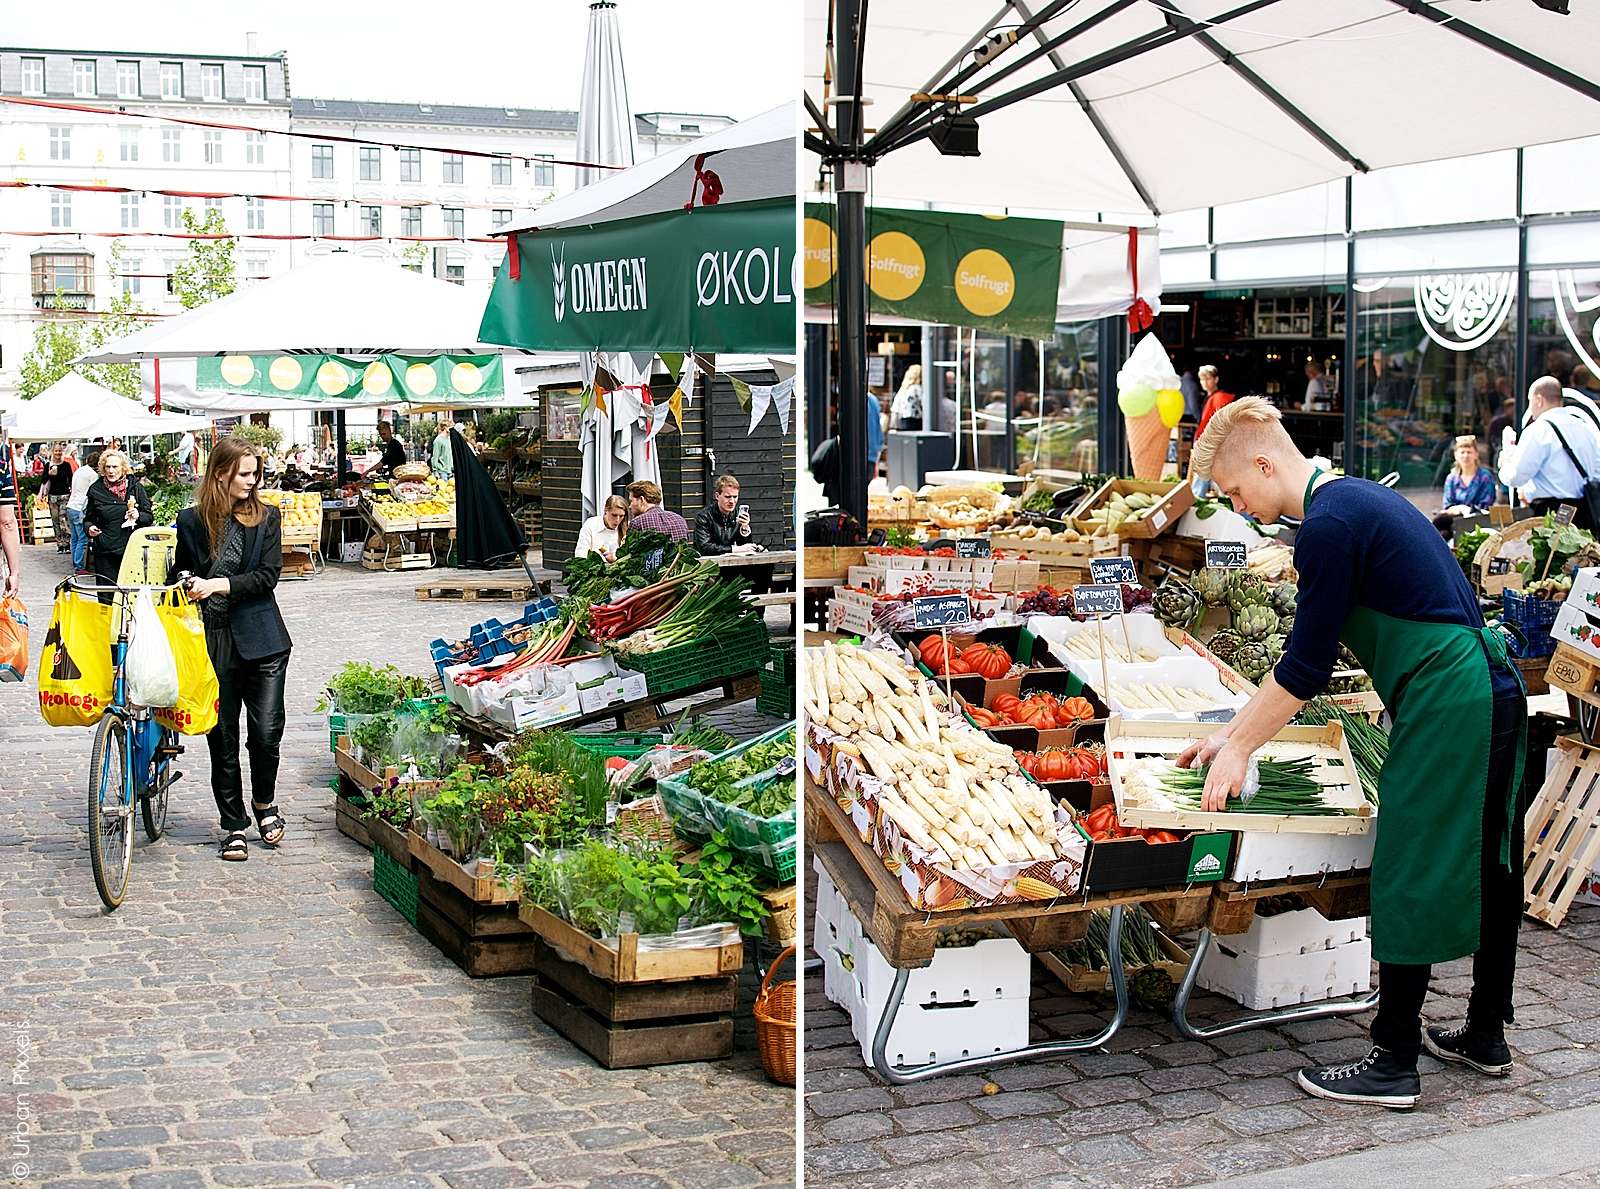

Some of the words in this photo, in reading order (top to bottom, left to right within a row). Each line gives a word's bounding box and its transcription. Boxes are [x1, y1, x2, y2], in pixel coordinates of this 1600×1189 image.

[696, 246, 796, 308] ØKOL
[870, 254, 921, 280] Solfrugt
[570, 257, 648, 314] OMEGN
[960, 271, 1011, 296] Solfrugt
[1555, 661, 1577, 681] EPAL
